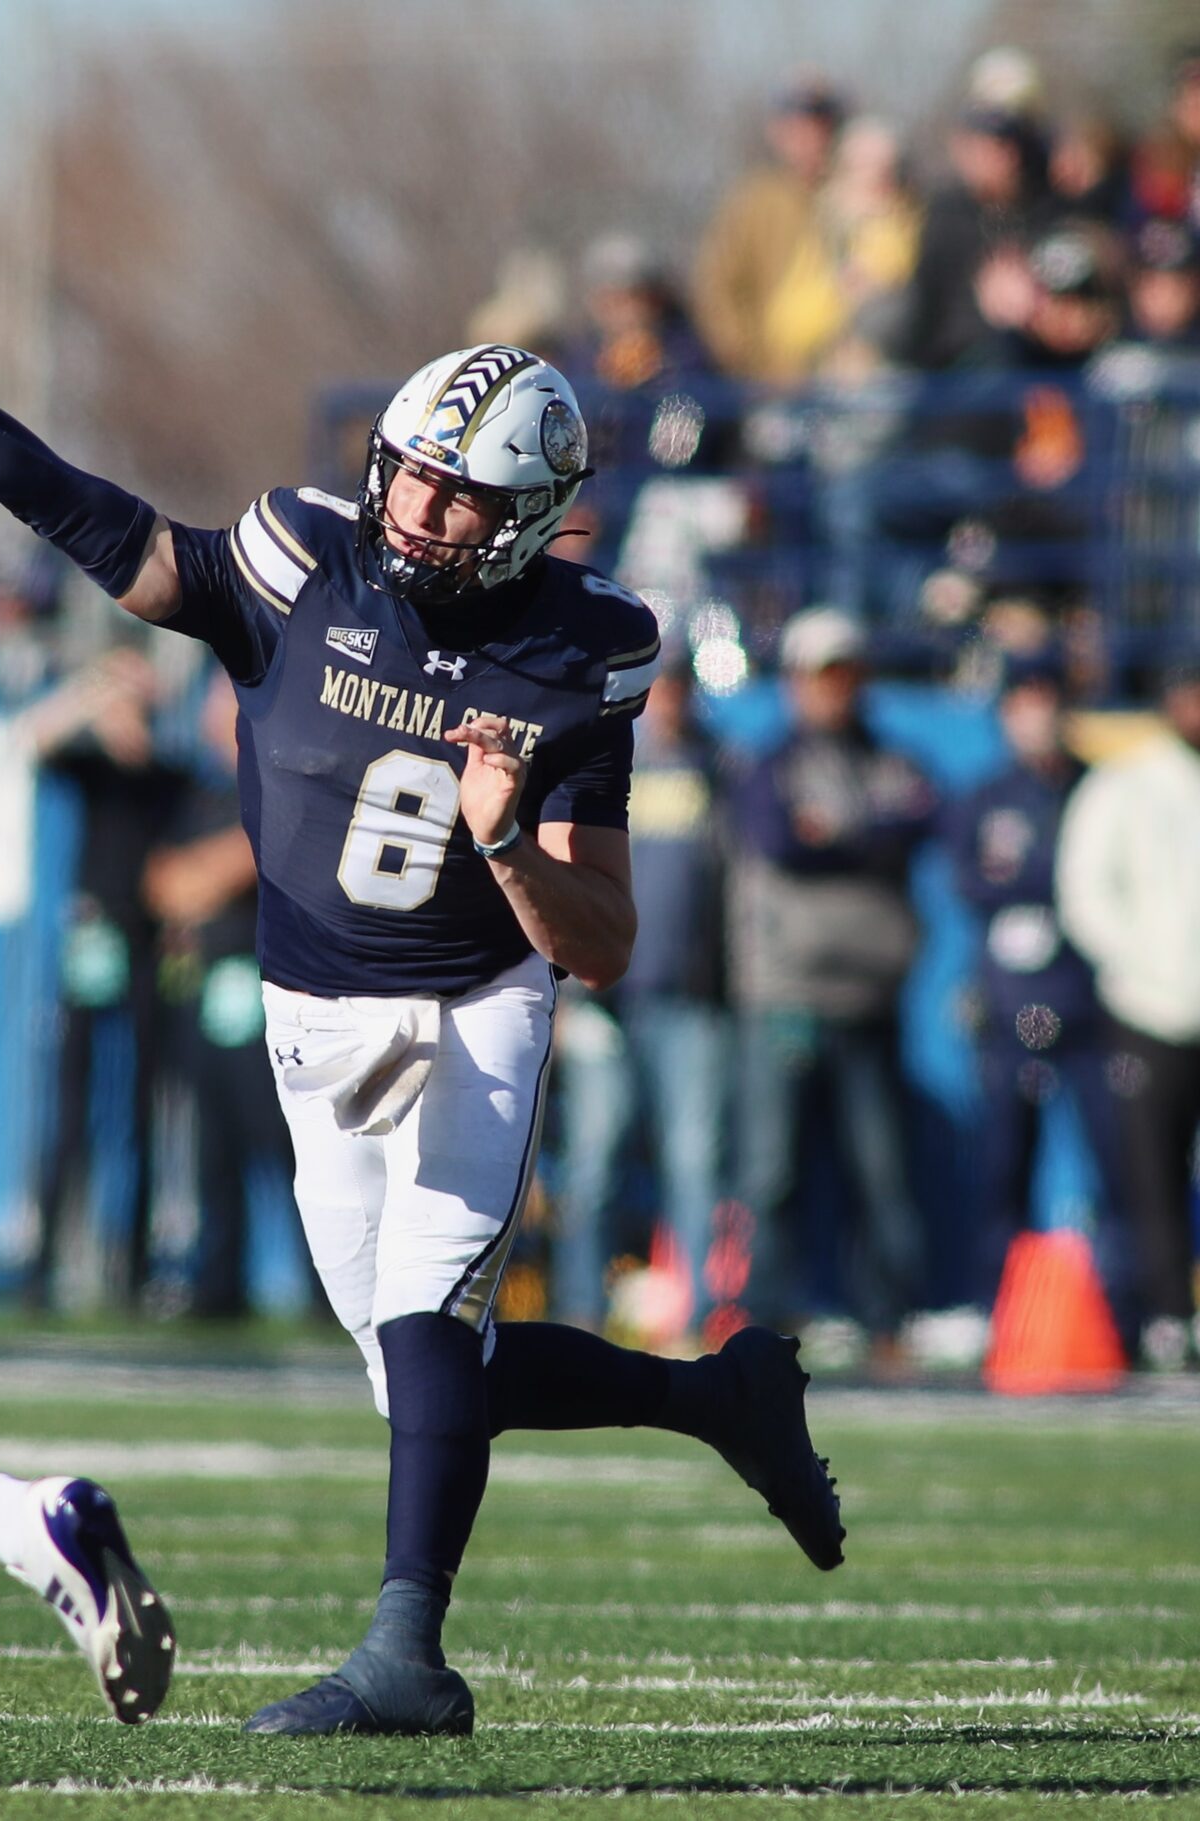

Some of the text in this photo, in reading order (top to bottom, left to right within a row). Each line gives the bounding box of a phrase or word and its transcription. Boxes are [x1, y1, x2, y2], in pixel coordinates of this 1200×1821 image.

[320, 665, 544, 759] MONTANA STE
[337, 749, 461, 912] 8
